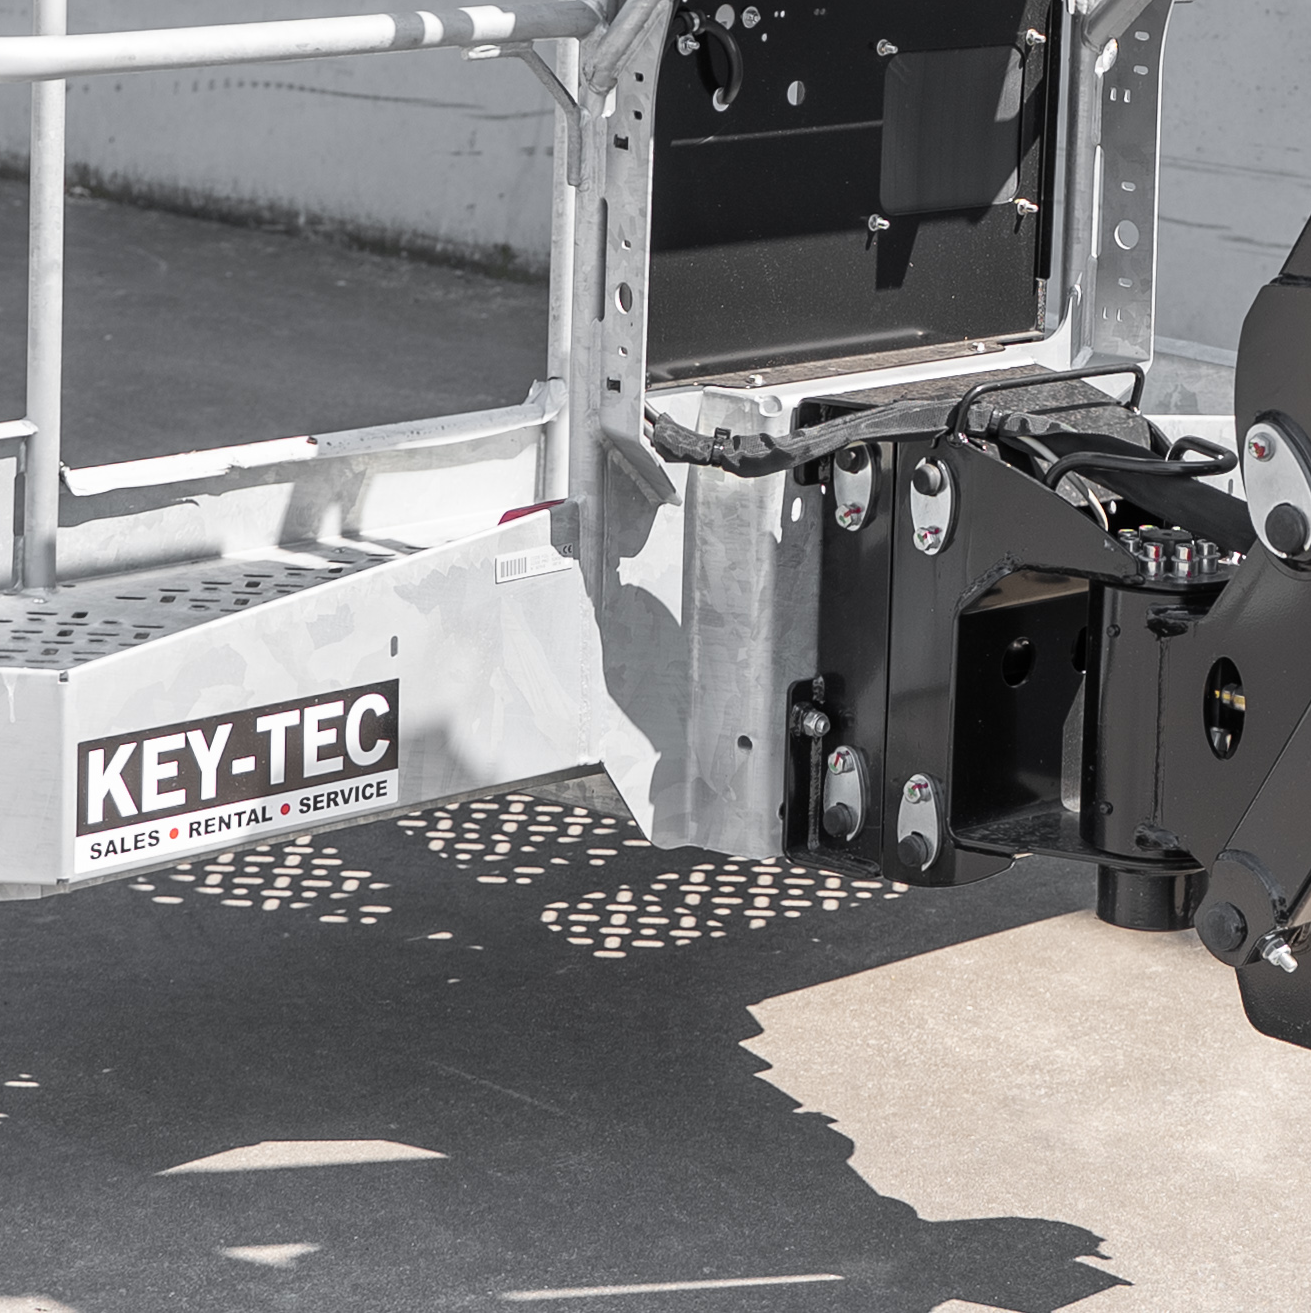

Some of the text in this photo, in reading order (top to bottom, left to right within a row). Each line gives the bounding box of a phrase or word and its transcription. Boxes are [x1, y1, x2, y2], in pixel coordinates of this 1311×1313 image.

[87, 692, 391, 825] KEY-TEC
[90, 780, 388, 860] SALES RENTAL SERVICE
